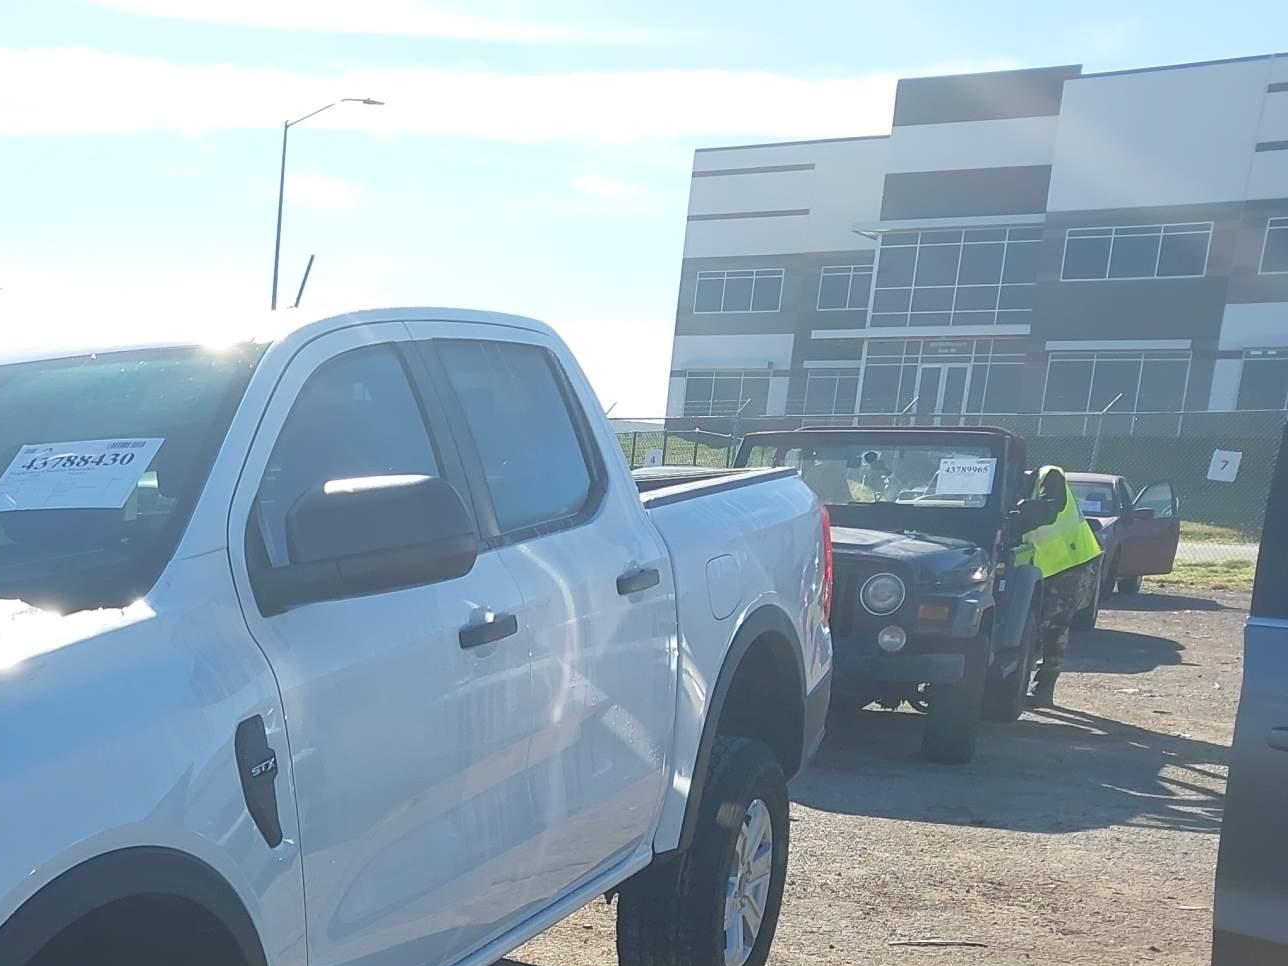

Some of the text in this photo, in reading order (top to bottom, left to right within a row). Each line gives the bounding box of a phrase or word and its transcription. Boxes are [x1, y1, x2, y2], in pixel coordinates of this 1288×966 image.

[21, 452, 135, 471] 43788430
[1220, 460, 1229, 471] 7
[251, 757, 276, 776] STX
